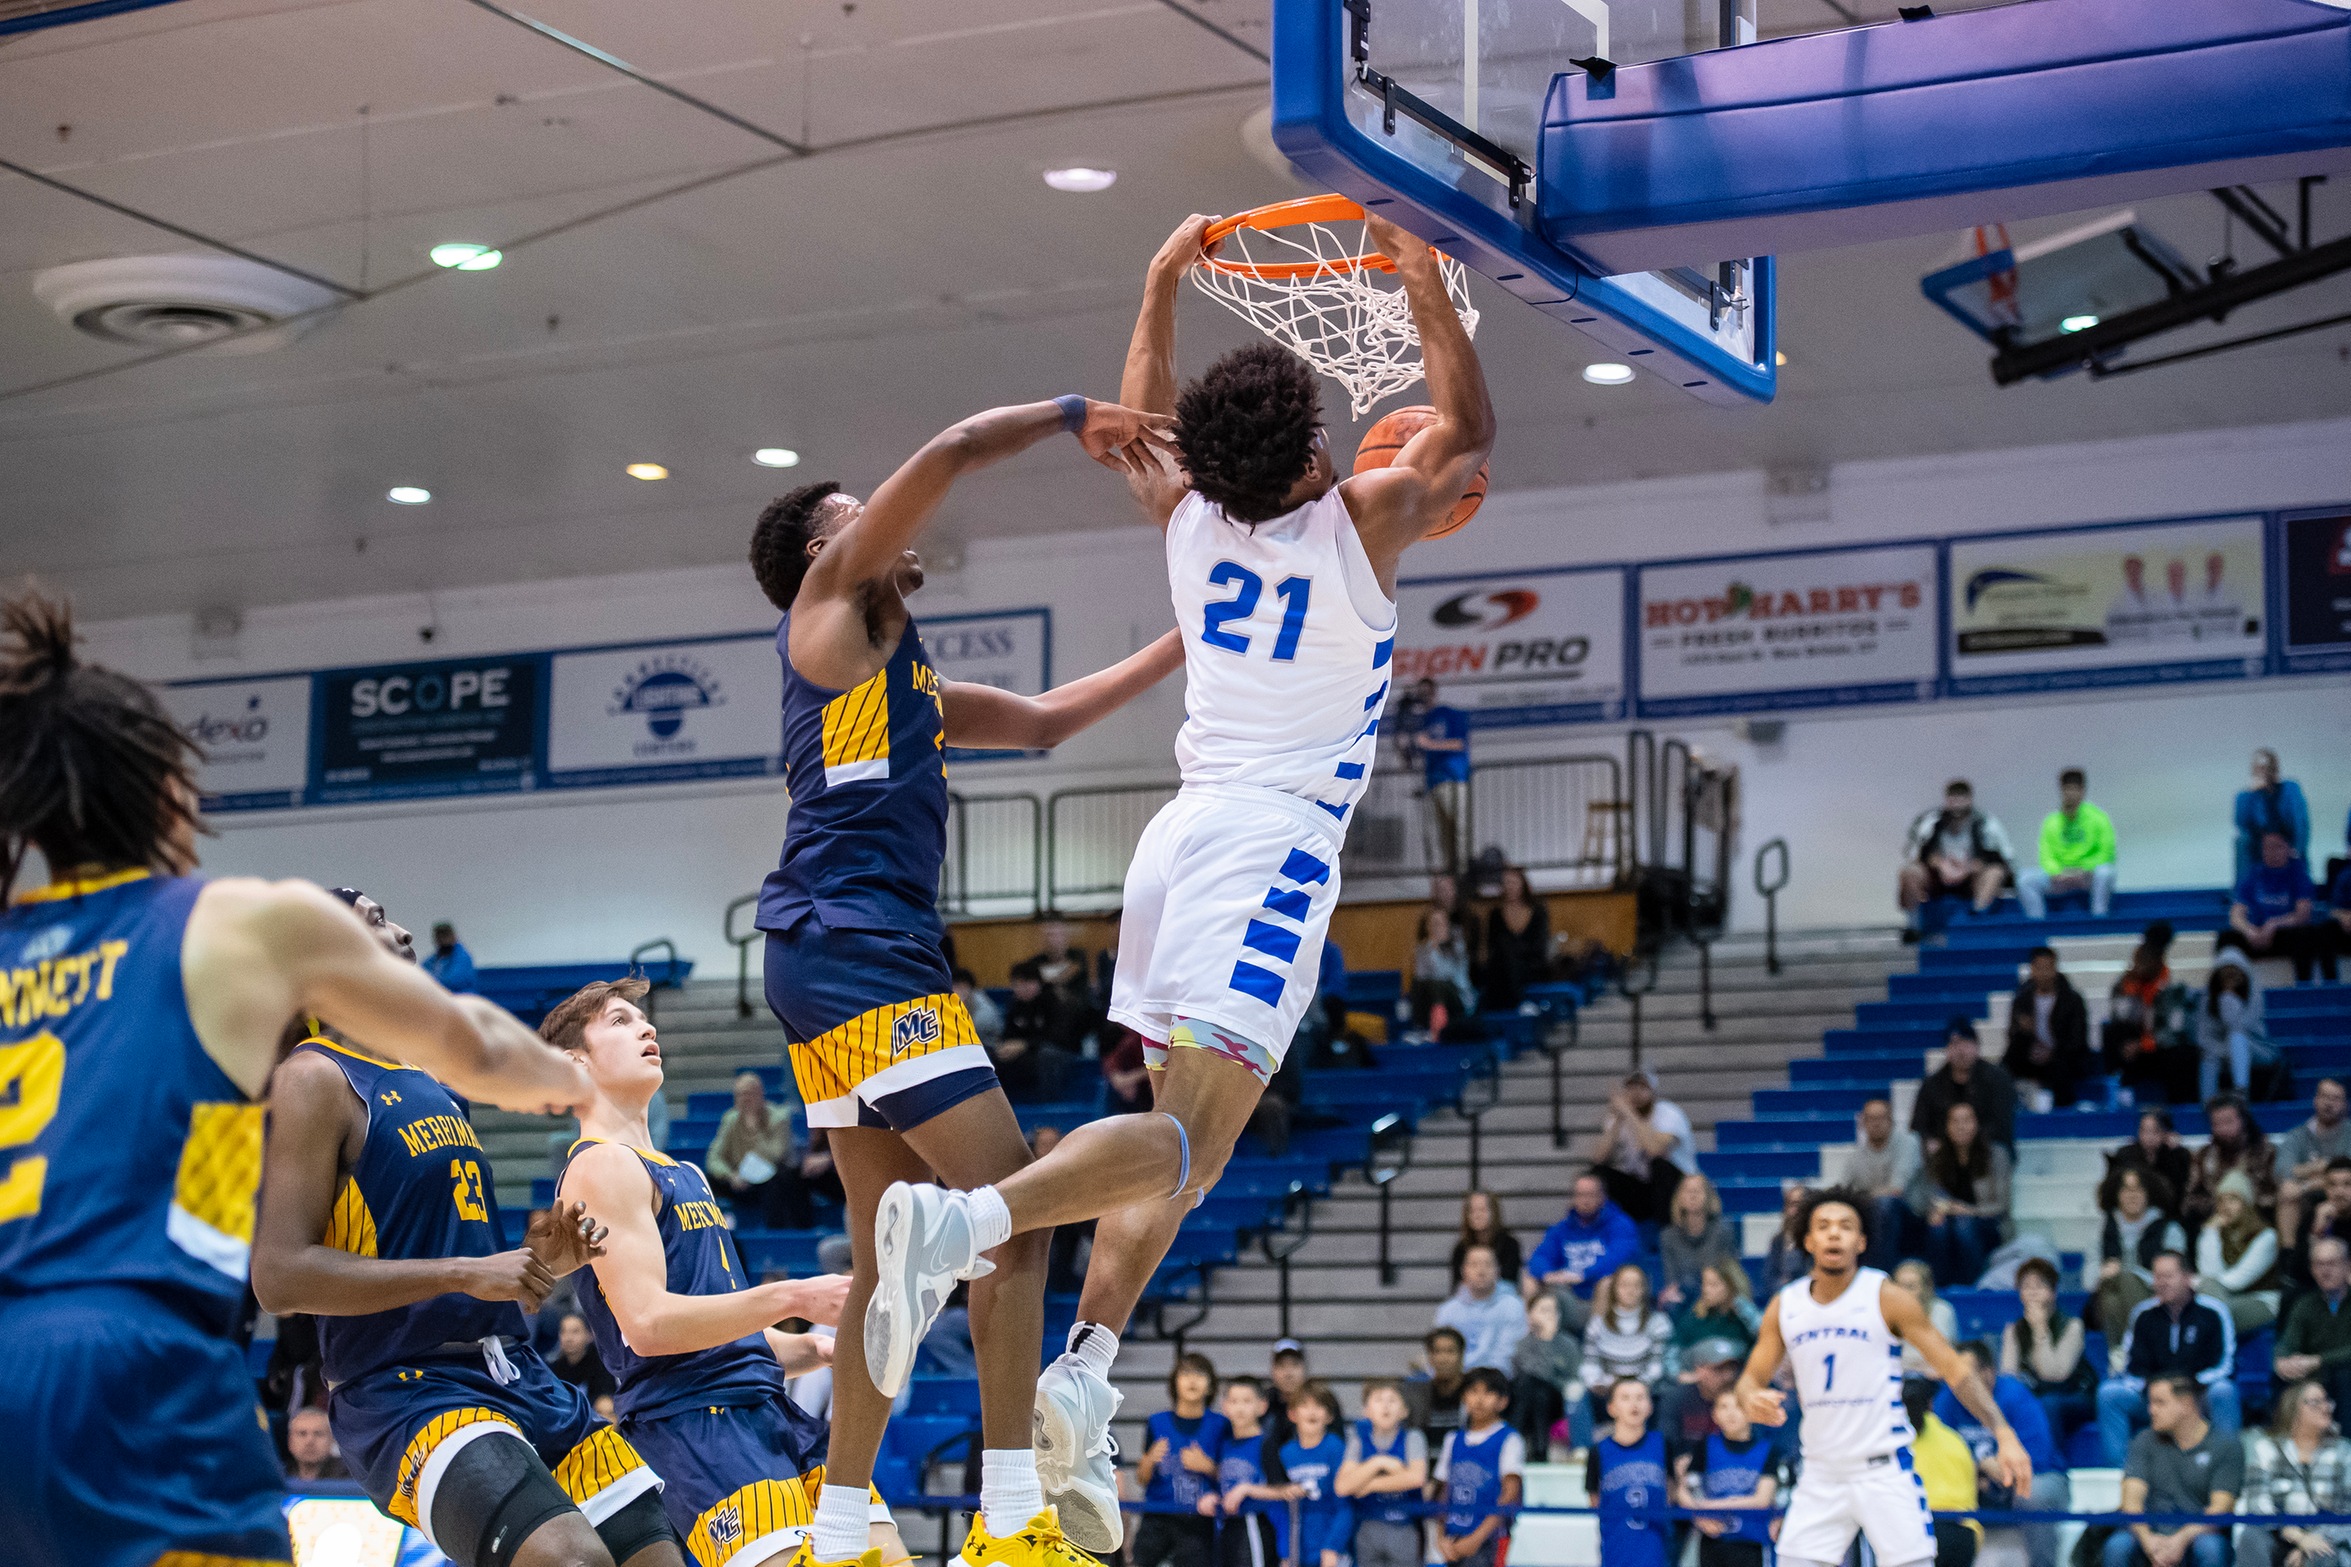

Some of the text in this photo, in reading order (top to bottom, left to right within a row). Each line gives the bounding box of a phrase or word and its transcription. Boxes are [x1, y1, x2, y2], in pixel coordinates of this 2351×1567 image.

[1201, 558, 1314, 664] 21
[1646, 580, 1922, 628] HOT HARRY'S
[1495, 635, 1591, 669] PRO
[350, 667, 513, 718] SCOPE
[892, 1005, 941, 1057] MC
[450, 1158, 489, 1223] 23
[1822, 1353, 1836, 1393] 1
